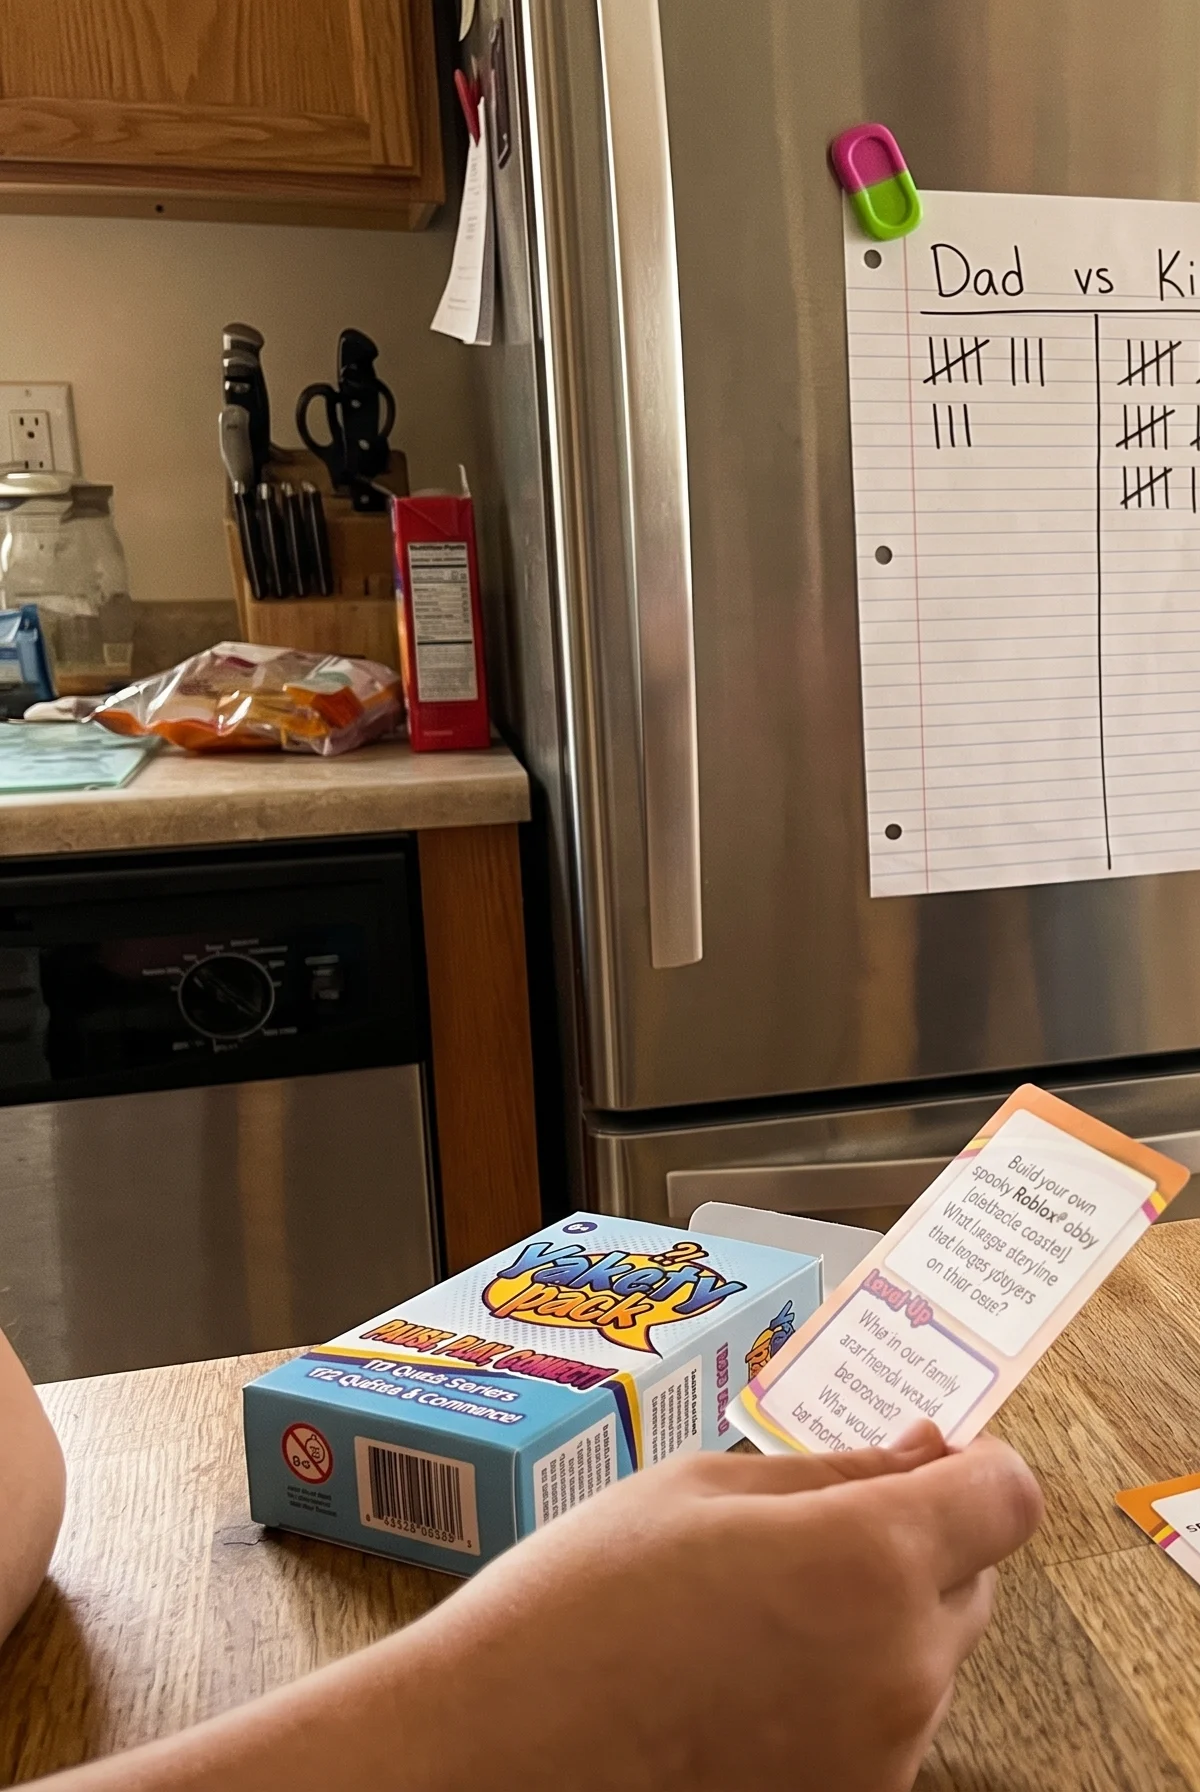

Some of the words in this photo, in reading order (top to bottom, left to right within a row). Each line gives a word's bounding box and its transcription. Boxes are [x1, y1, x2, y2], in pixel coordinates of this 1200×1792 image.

[931, 243, 1025, 298] Dad
[1075, 267, 1114, 295] vs
[972, 1165, 1014, 1197] spooky
[1063, 1220, 1099, 1250] obby
[1008, 1155, 1044, 1182] Build
[1035, 1177, 1069, 1198] your
[1068, 1193, 1096, 1216] own
[496, 1242, 747, 1314] Yakety
[927, 1258, 943, 1274] on
[489, 1282, 655, 1329] pack
[901, 1348, 925, 1366] our
